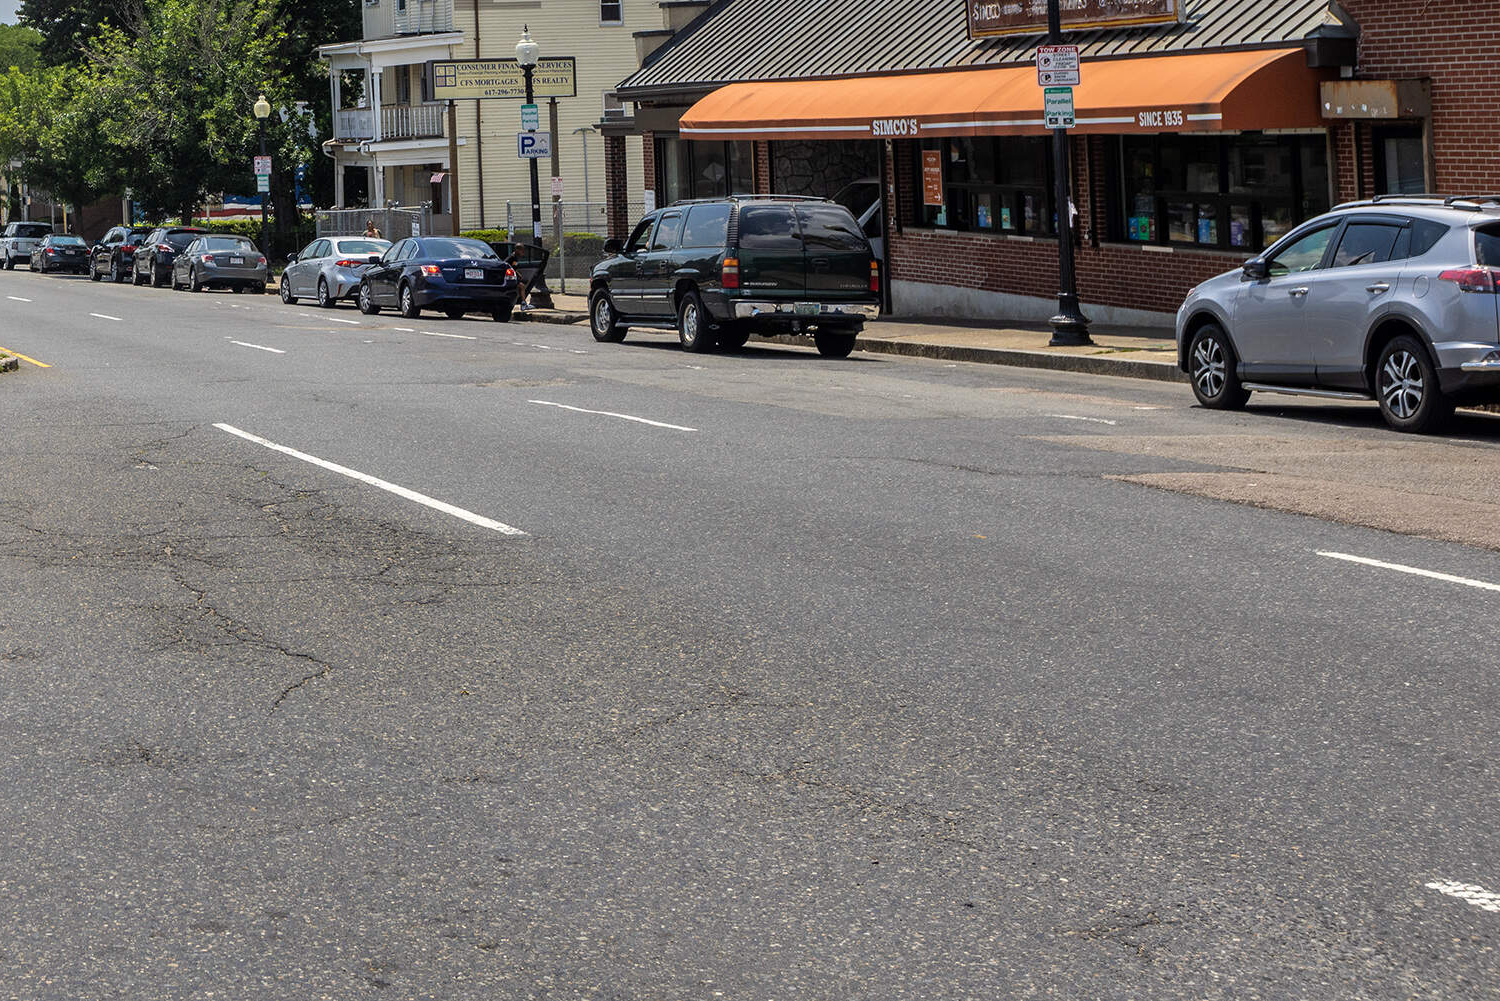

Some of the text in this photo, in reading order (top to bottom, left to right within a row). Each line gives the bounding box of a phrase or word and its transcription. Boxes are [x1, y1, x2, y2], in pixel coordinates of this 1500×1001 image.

[457, 63, 496, 71] CONSUMER
[475, 79, 518, 87] MORTGAGES
[1139, 110, 1183, 127] SINCE 1935
[872, 119, 918, 136] SIMCO'S
[521, 136, 548, 155] PARKING
